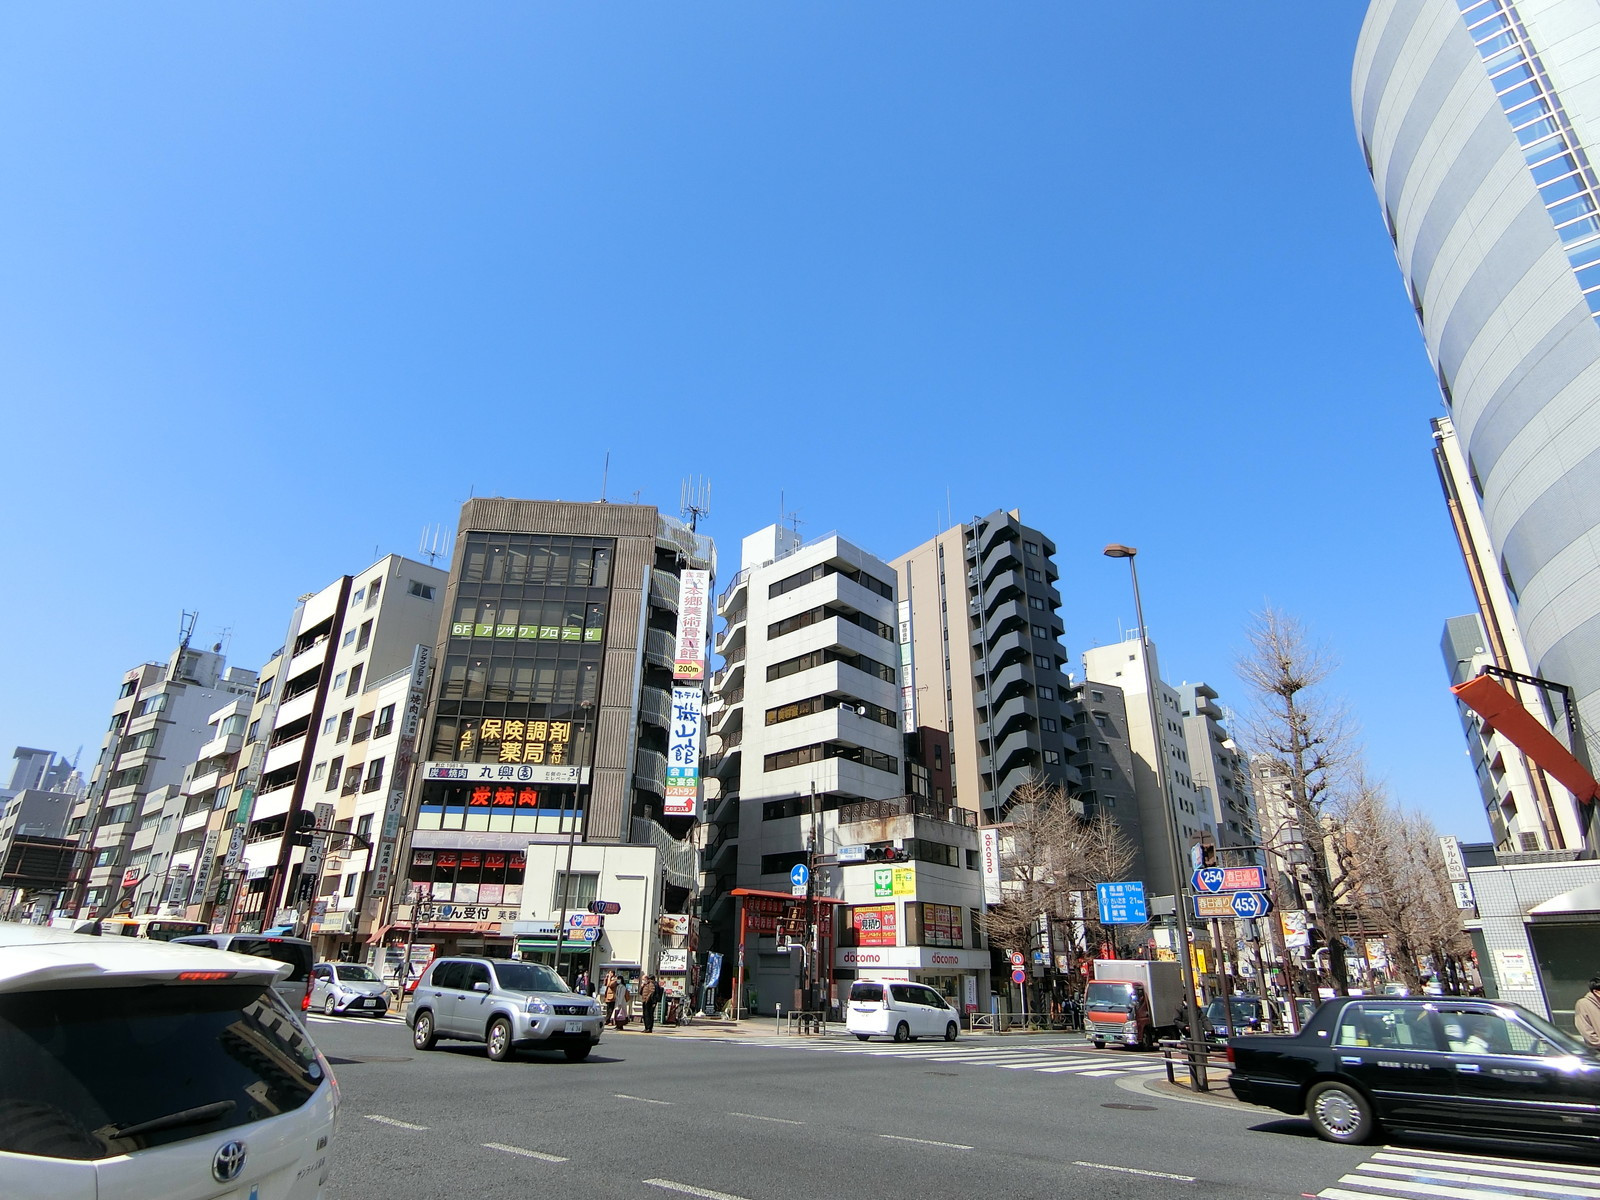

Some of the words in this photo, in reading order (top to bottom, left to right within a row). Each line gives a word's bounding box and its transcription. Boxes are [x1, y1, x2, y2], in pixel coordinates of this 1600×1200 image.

[453, 625, 471, 635] 6F
[680, 586, 703, 659] 本郷美術骨董館
[678, 665, 699, 673] 200m
[674, 690, 702, 699] ホテル
[409, 694, 422, 714] 焼肉
[480, 719, 571, 743] 保険調剤
[459, 730, 472, 751] 4F
[499, 742, 545, 763] 薬局
[550, 743, 563, 764] 受付
[430, 768, 467, 778] 炭火焼肉
[470, 786, 538, 807] 炭焼肉
[666, 787, 696, 796] レストラン
[389, 792, 404, 812] くすり
[985, 834, 993, 874] docomo
[1443, 838, 1458, 865] シャルム
[1203, 871, 1223, 883] 254
[1226, 870, 1259, 882] 春日通り
[1199, 898, 1230, 909] 春日通り
[1234, 898, 1256, 911] 453
[861, 919, 881, 930] 見積り
[844, 952, 881, 963] docomo
[931, 952, 959, 965] docomo
